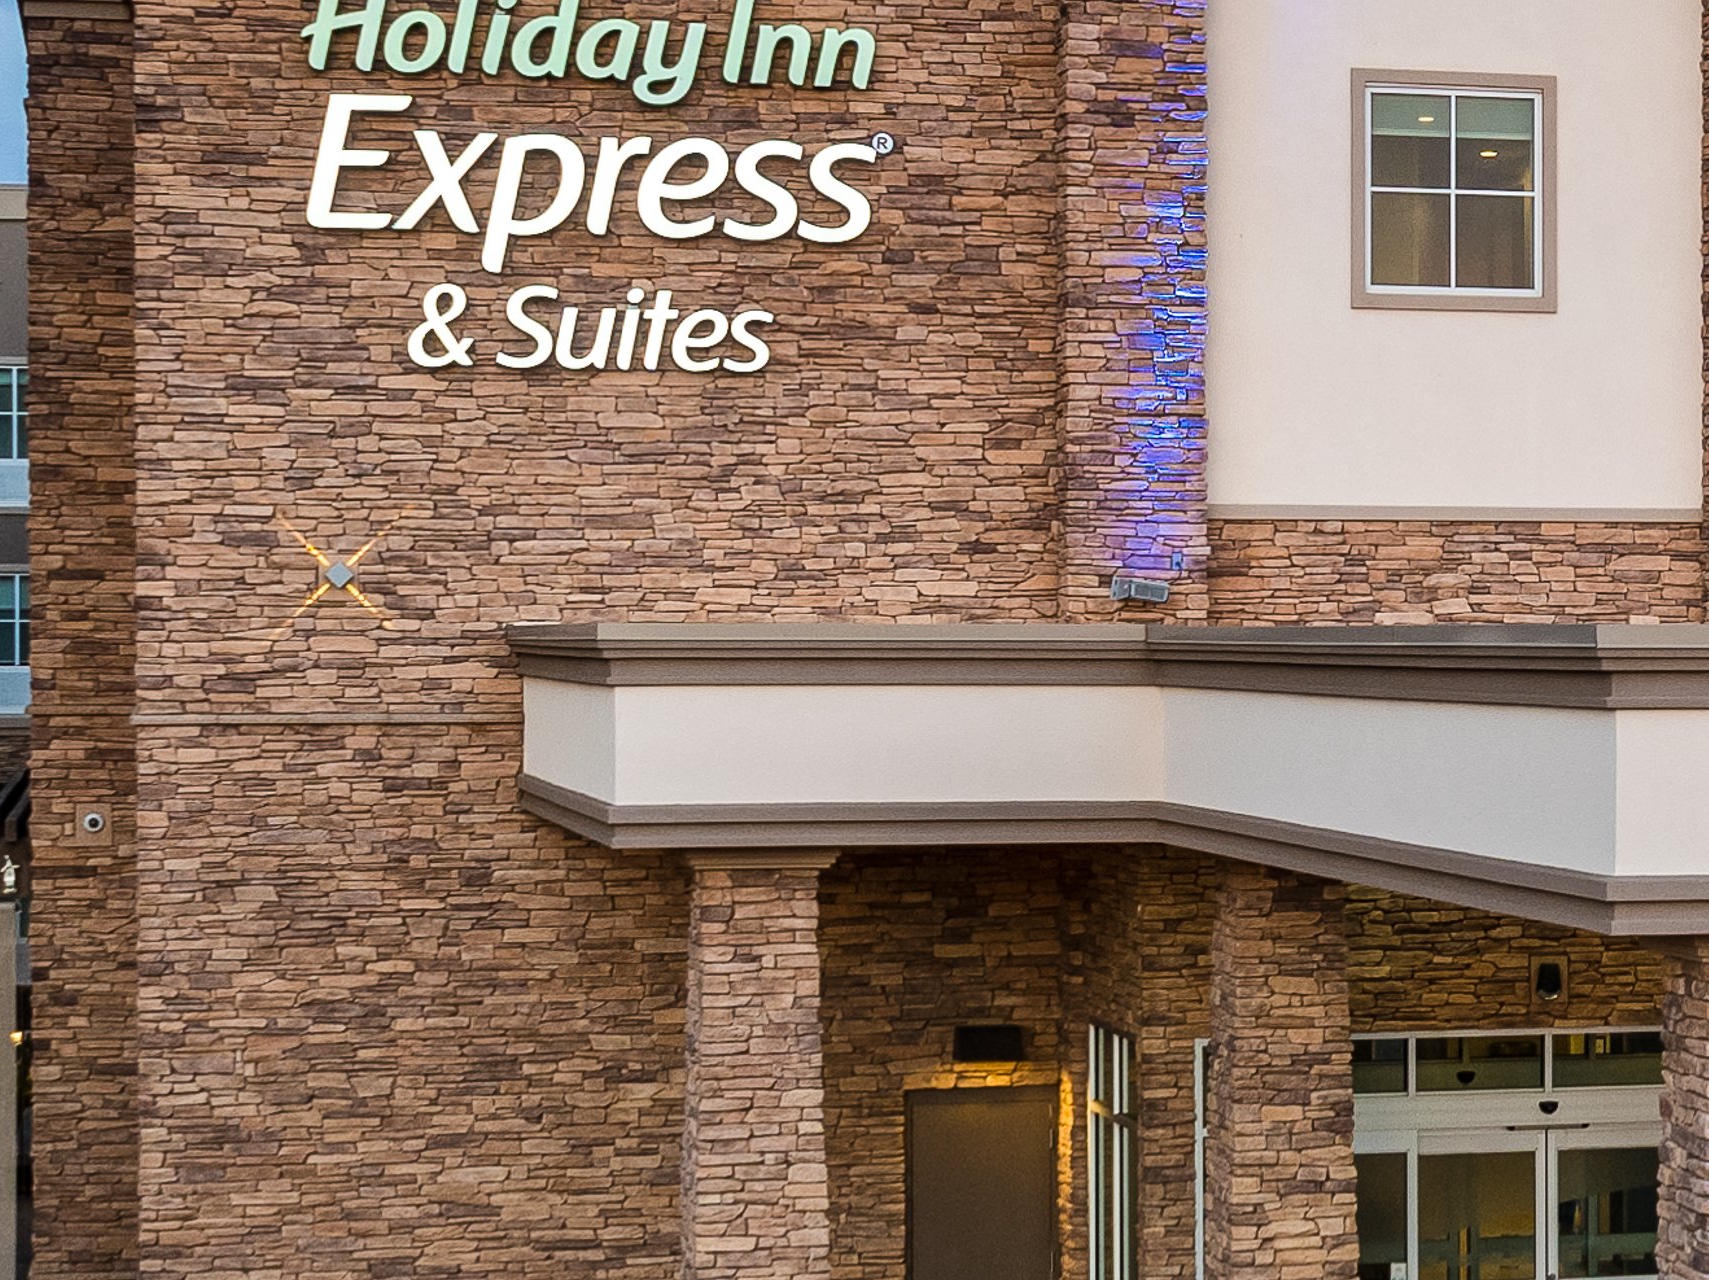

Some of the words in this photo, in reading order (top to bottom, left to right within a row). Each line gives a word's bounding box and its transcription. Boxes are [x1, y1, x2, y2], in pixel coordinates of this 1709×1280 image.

[305, 94, 877, 273] Express
[407, 283, 475, 368] &
[496, 285, 775, 373] Suites
